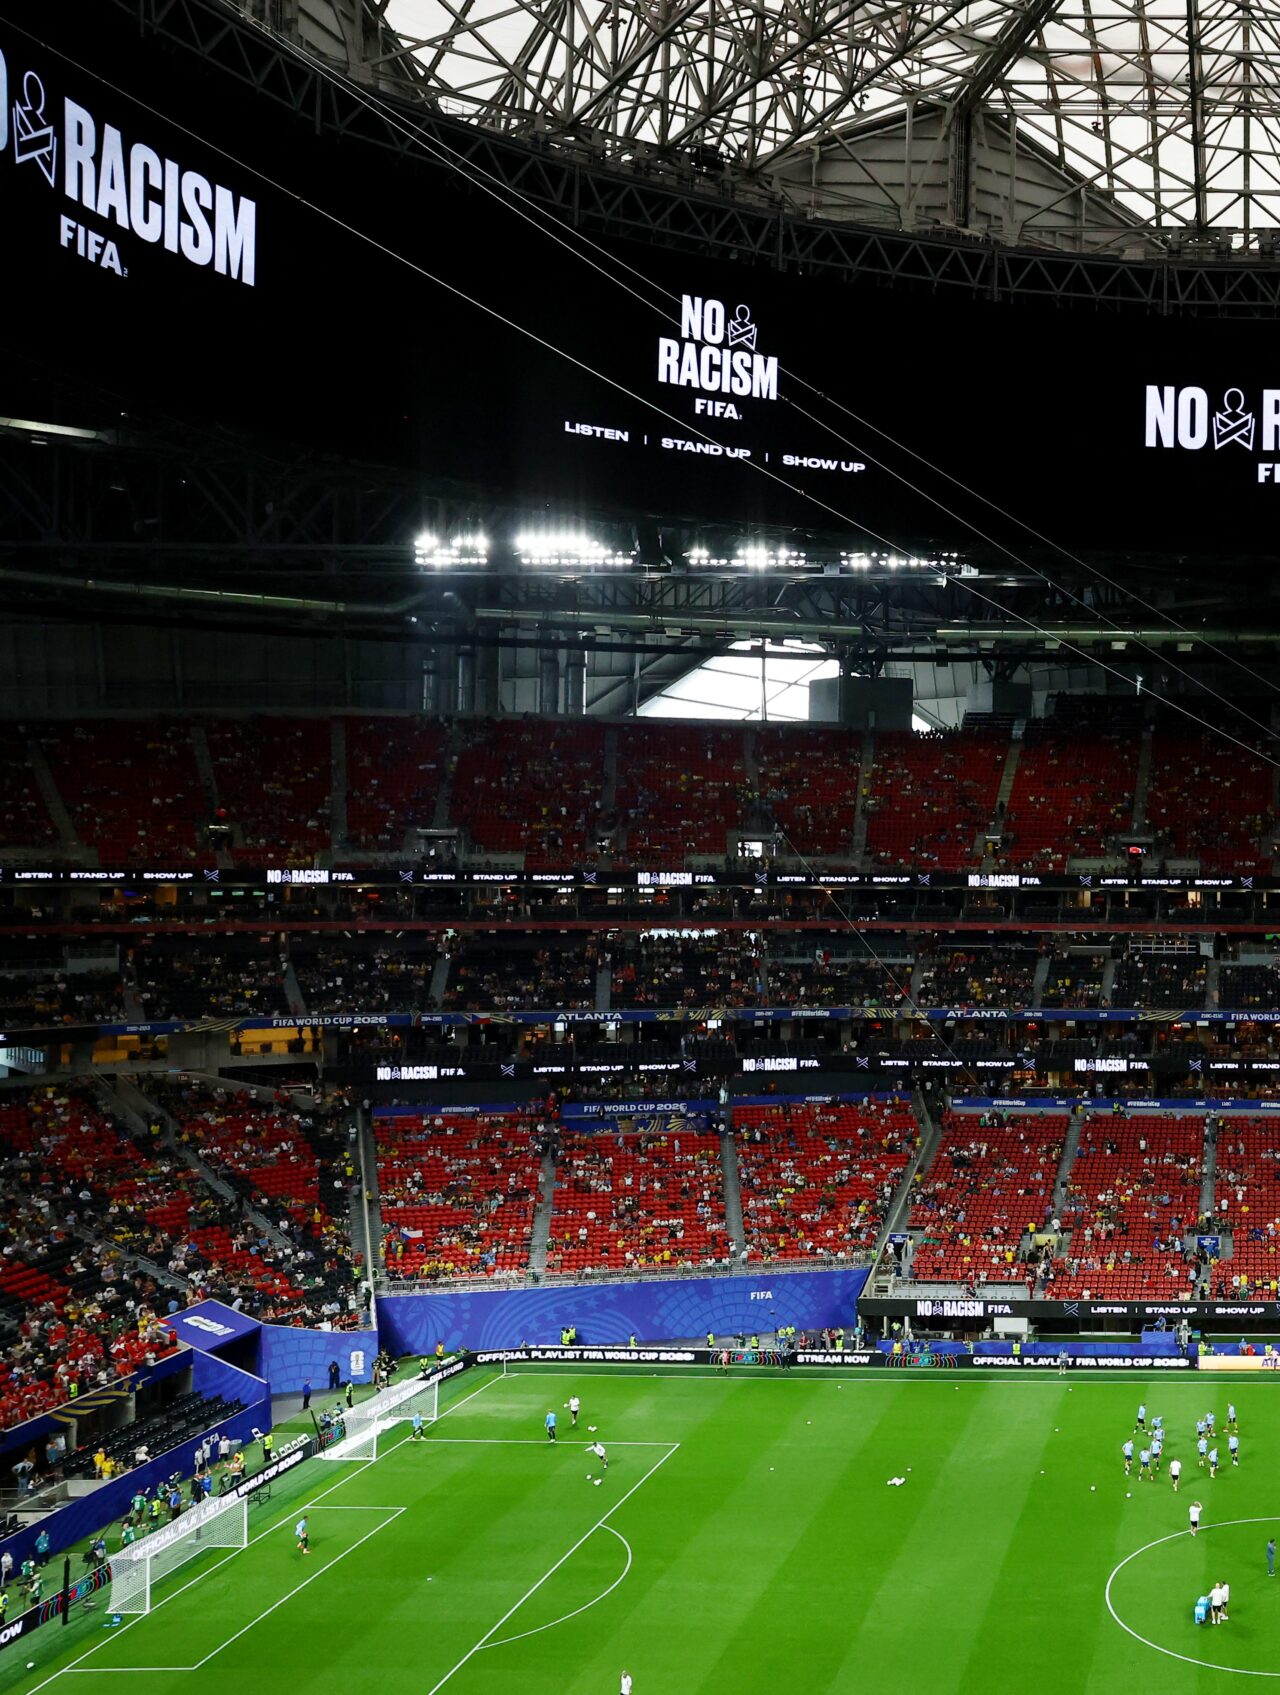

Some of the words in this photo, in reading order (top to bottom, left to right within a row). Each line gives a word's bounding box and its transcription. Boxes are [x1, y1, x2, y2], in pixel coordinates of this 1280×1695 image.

[64, 96, 255, 286] RACISM
[60, 214, 122, 277] FIFA
[681, 294, 725, 344] NO
[658, 337, 778, 400] RACISM
[695, 398, 739, 420] FIFA
[1145, 385, 1208, 450] NO
[564, 421, 629, 441] LISTEN
[661, 437, 723, 456] STAND
[725, 446, 751, 459] UP
[782, 454, 838, 470] SHOW
[841, 461, 866, 473] UP
[267, 870, 281, 883] NO
[292, 870, 328, 883] RACISM
[331, 872, 354, 881] FIFA
[638, 873, 650, 884] NO
[659, 873, 692, 884] RACISM
[694, 874, 715, 883] FIFA
[968, 875, 980, 886] NO
[987, 875, 1019, 887] RACISM
[1021, 877, 1041, 885] FIFA
[272, 1018, 295, 1027] FIFA
[295, 1017, 332, 1026] WORLD
[332, 1016, 353, 1025] CUP
[353, 1016, 388, 1024] 2026
[556, 1012, 623, 1021] ATLANTA
[1231, 1013, 1250, 1021] FIFA
[1249, 1013, 1280, 1021] WORLD
[743, 1059, 755, 1071] NO
[765, 1058, 797, 1070] RACISM
[799, 1059, 821, 1068] FIFA
[377, 1067, 391, 1080] NO
[401, 1066, 437, 1079] RACISM
[440, 1067, 466, 1076] FIFA
[604, 1104, 637, 1113] WORLD
[637, 1103, 656, 1111] CUP
[750, 1290, 773, 1300] FIFA
[917, 1301, 932, 1316] NO
[944, 1301, 984, 1316] RACISM
[987, 1304, 1011, 1314] FIFA
[1090, 1306, 1128, 1314] LISTEN
[1145, 1306, 1181, 1314] STAND
[477, 1351, 529, 1362] OFFICIAL
[531, 1350, 581, 1359] PLAYLIST
[584, 1350, 603, 1360] FIFA
[604, 1351, 638, 1360] WORLD
[639, 1351, 658, 1361] CUP
[797, 1354, 842, 1364] STREAM
[844, 1355, 869, 1364] NOW
[973, 1356, 1020, 1366] OFFICIAL
[1024, 1357, 1074, 1367] PLAYLIT
[1076, 1357, 1097, 1367] FIFA
[1097, 1357, 1132, 1367] WORLD
[1133, 1357, 1152, 1367] CUP
[238, 1476, 264, 1497] WORLD
[0, 1620, 23, 1643] OW
